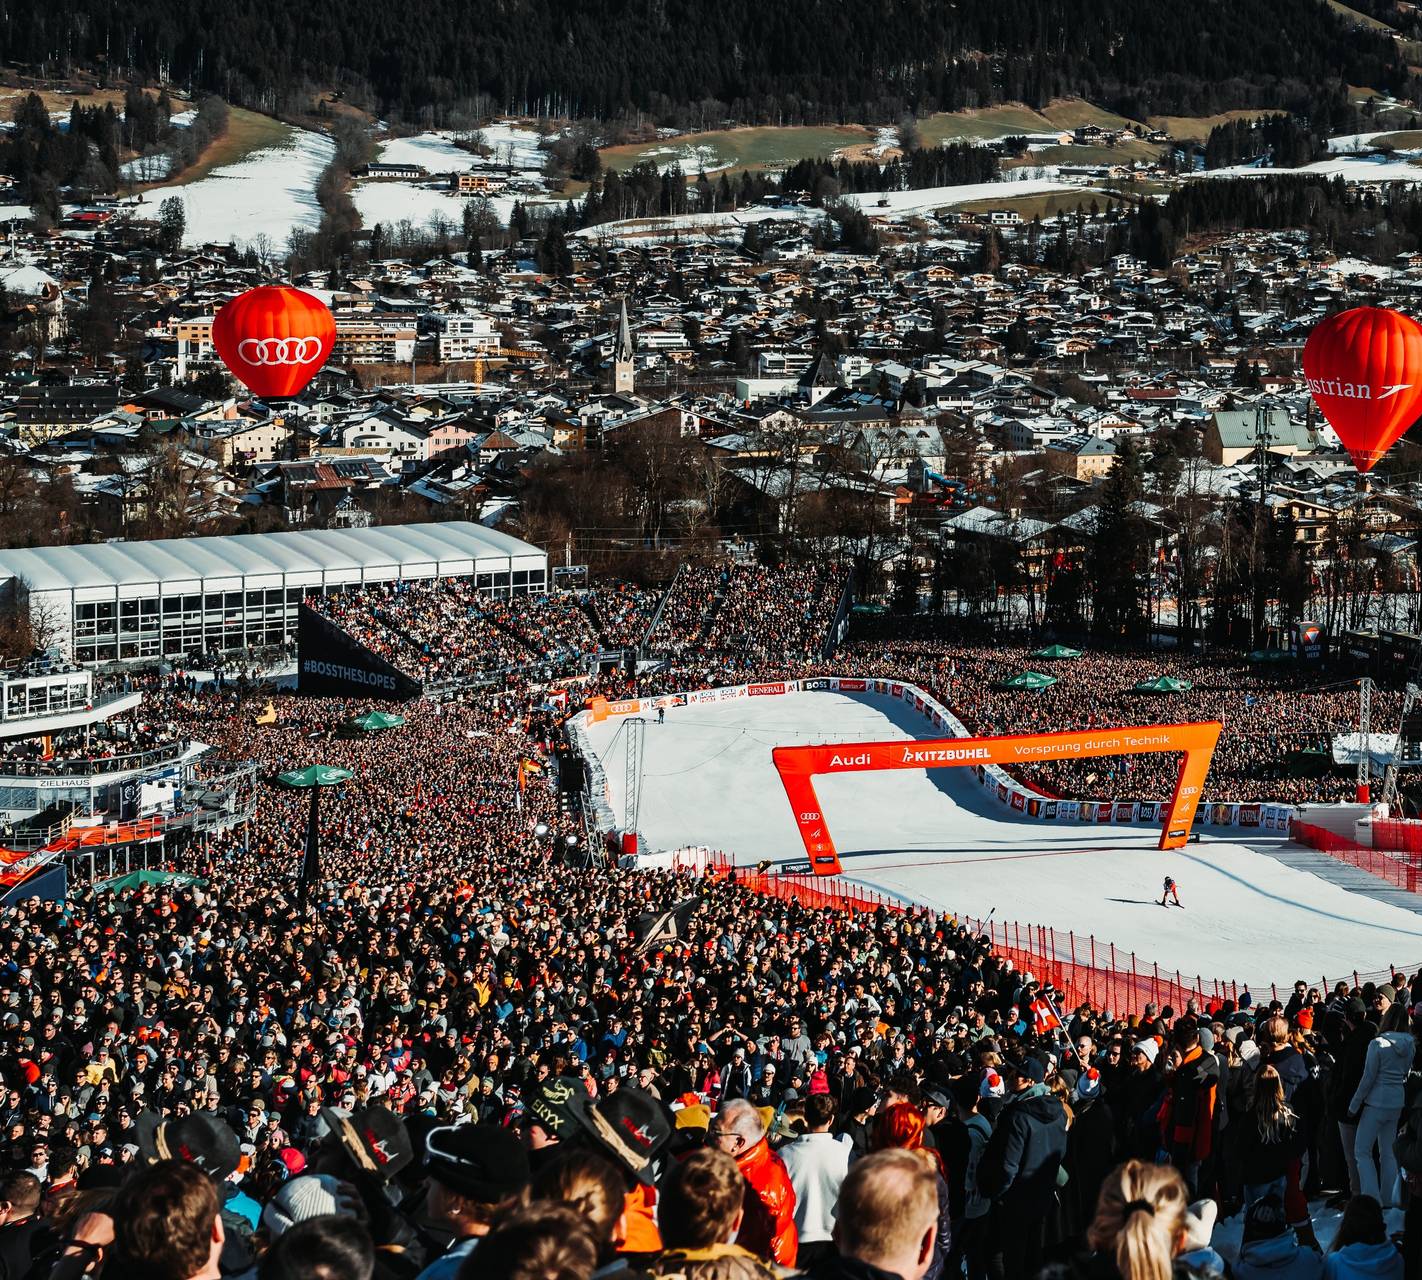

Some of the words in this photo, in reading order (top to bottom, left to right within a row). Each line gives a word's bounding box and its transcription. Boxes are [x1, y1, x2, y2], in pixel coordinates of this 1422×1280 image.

[1306, 376, 1371, 399] ustrian
[303, 659, 396, 690] #BOSSTHESLOPES
[748, 685, 784, 695] GENERALI
[806, 680, 827, 690] BOSS
[1014, 741, 1081, 755] Vorsprung
[1084, 739, 1120, 750] durch
[1123, 735, 1170, 746] Technik
[829, 753, 871, 767] Audi
[39, 779, 90, 787] ZIELHAUS
[1141, 806, 1153, 818] BOSS
[531, 1099, 565, 1131] ERYX
